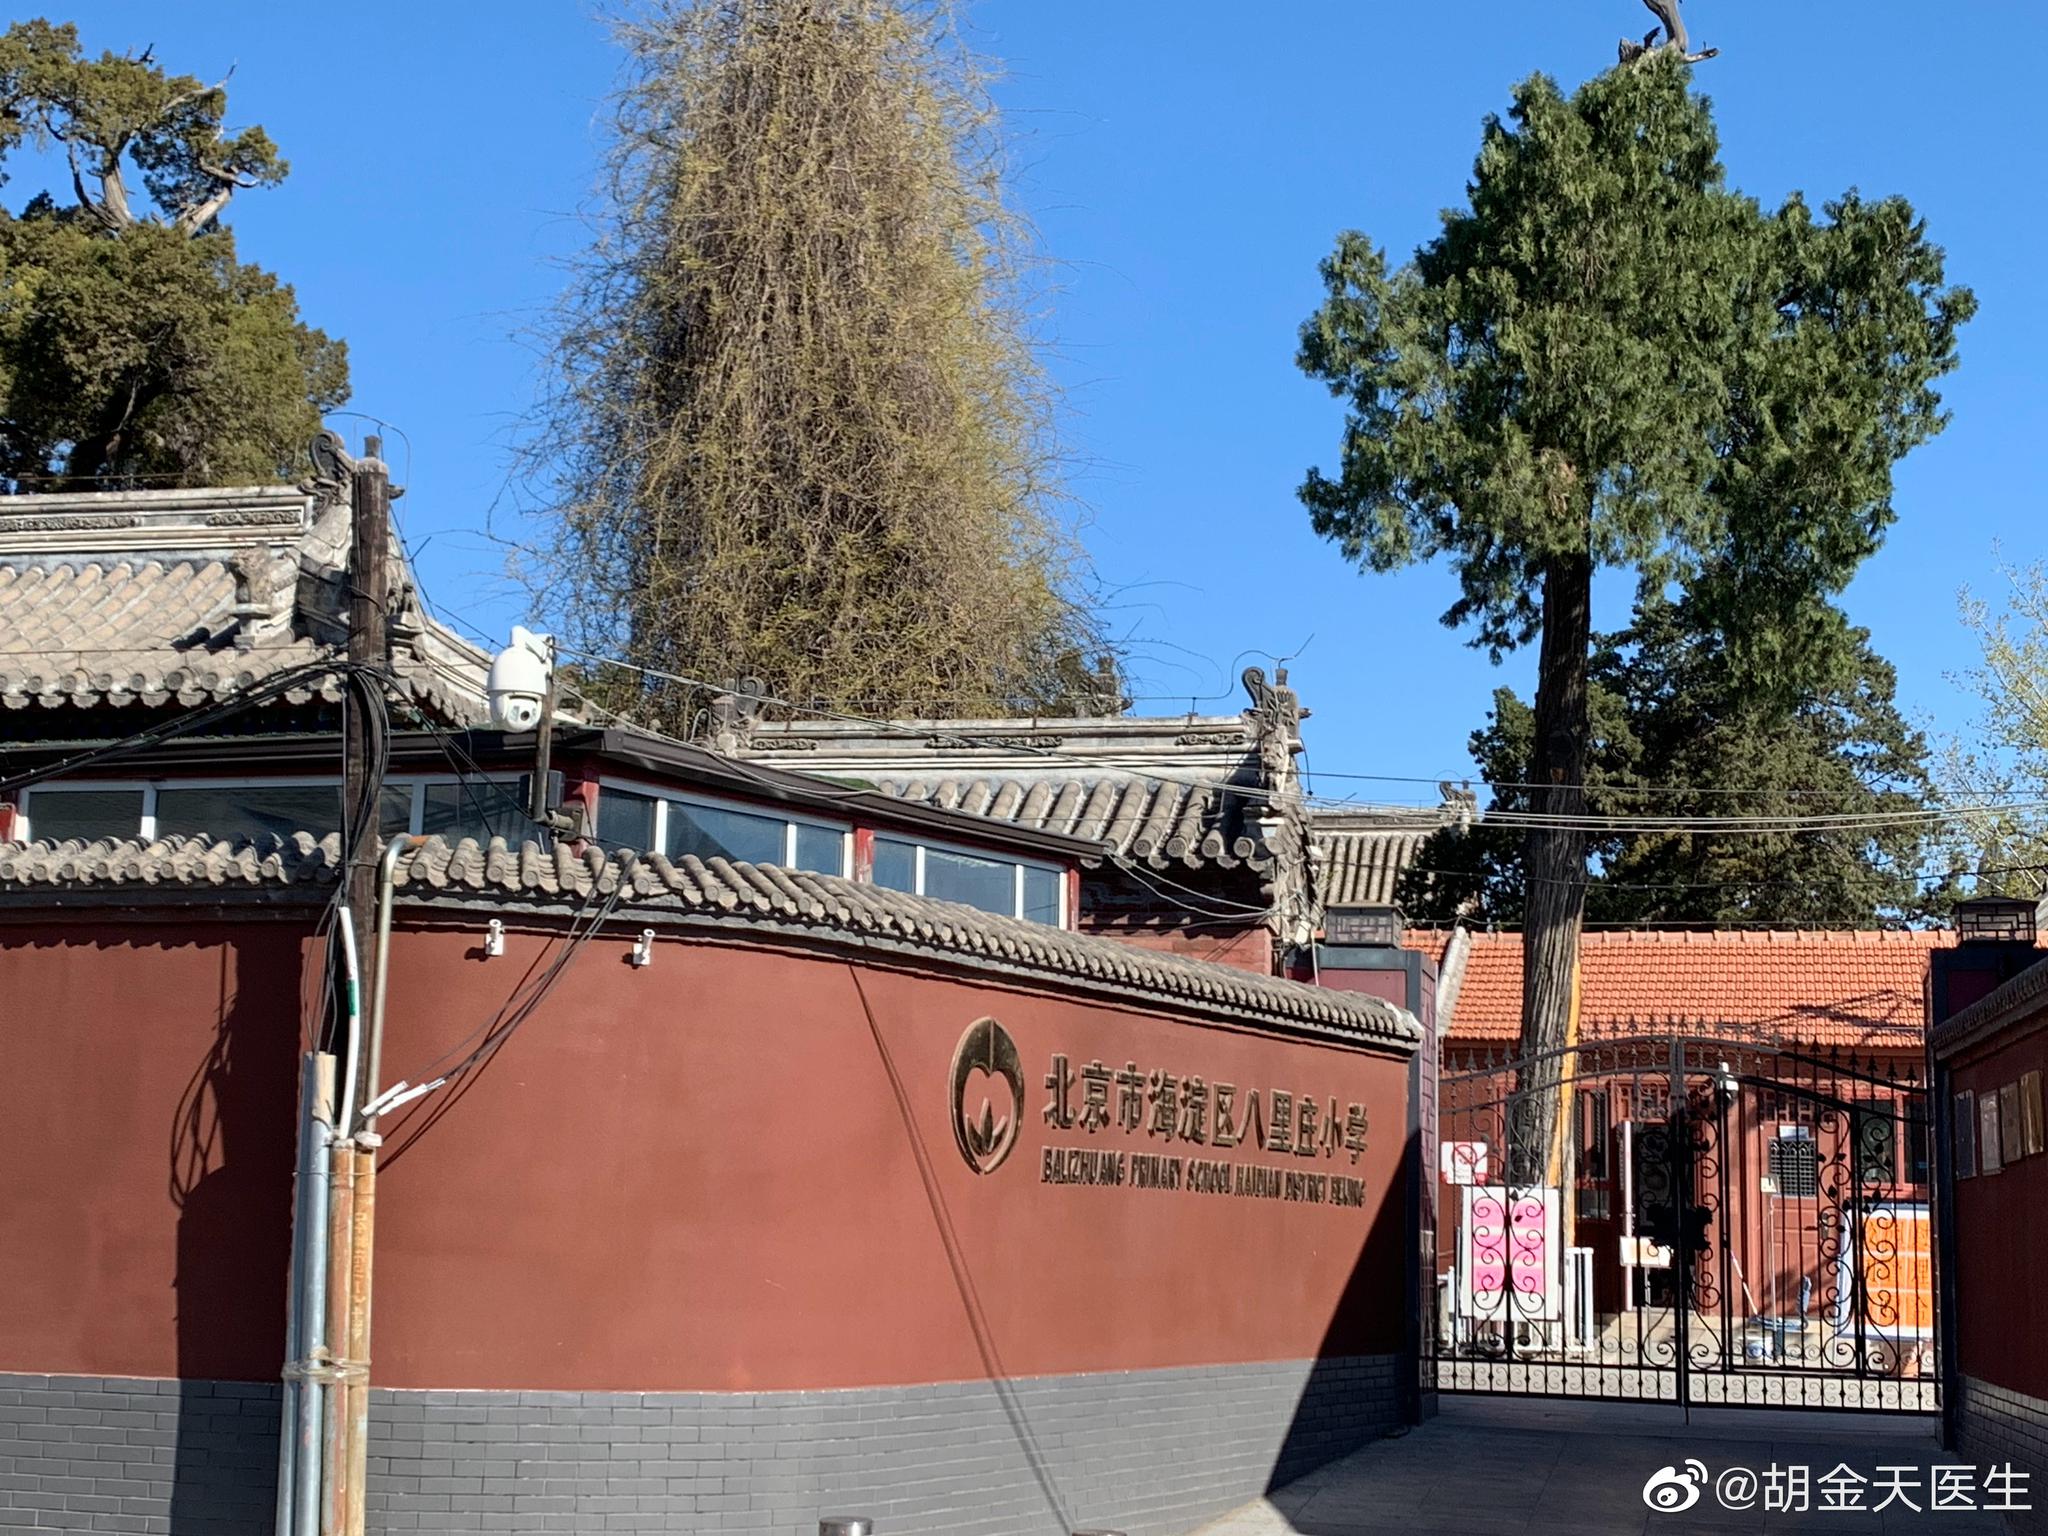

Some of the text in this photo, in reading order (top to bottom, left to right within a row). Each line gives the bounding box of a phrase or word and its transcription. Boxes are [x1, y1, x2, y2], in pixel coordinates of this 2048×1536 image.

[1043, 1053, 1368, 1163] 北京市海淀区八里庄小学
[1041, 1146, 1125, 1186] BALIZHUANG
[1128, 1152, 1183, 1190] PRIMARY
[1186, 1158, 1231, 1194] SCHOOL
